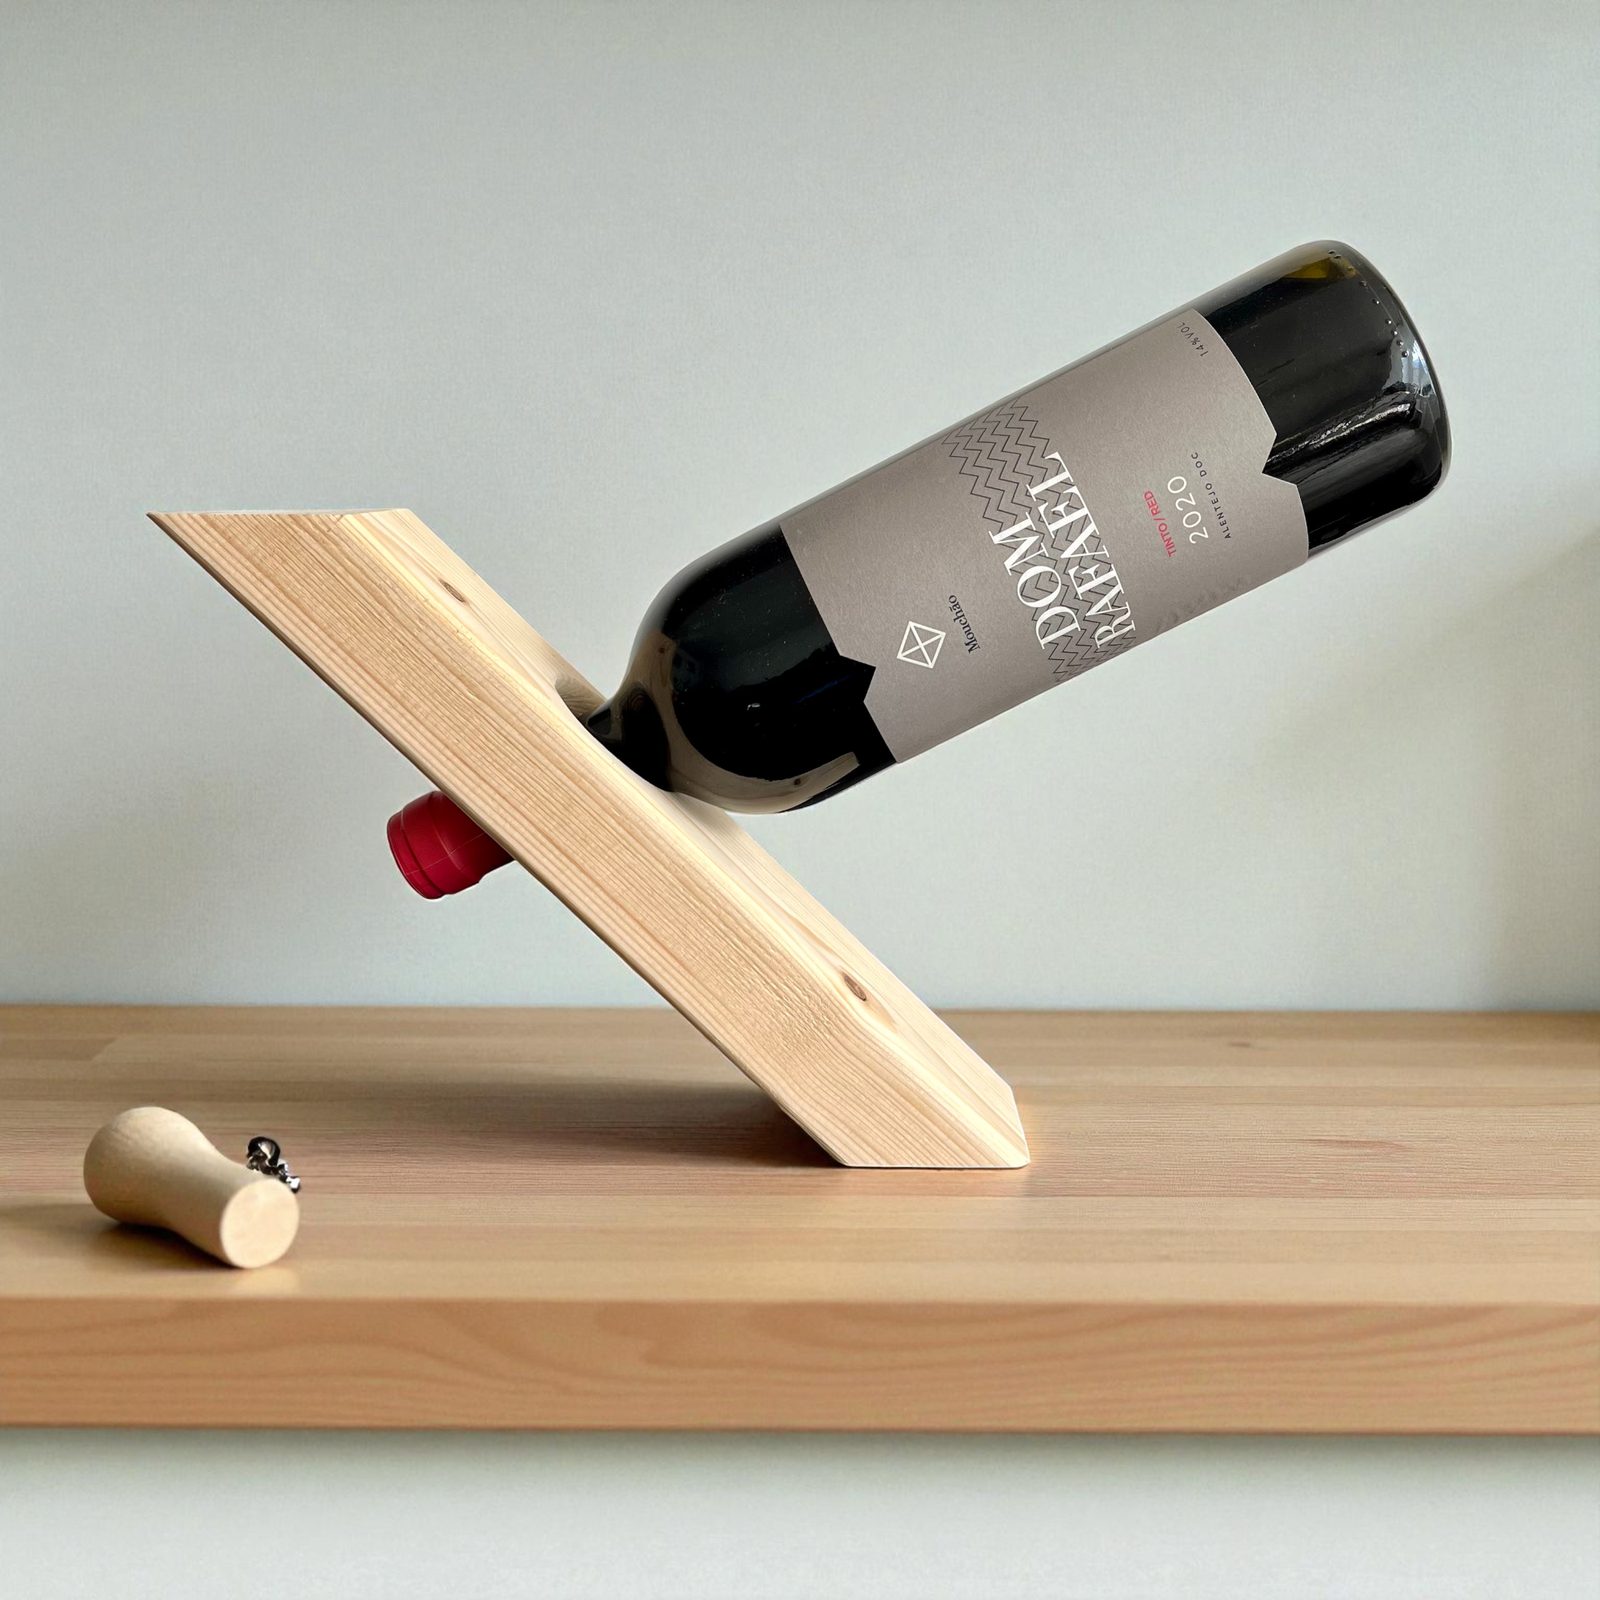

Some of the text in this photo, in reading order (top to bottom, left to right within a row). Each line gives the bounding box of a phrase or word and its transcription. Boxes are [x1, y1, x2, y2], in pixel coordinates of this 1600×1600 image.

[1167, 475, 1209, 544] 2020
[1191, 452, 1232, 540] ALENTEJO DOC
[988, 512, 1081, 649] DOM
[1026, 452, 1136, 648] RAFAEL
[948, 594, 981, 654] Mouchão
